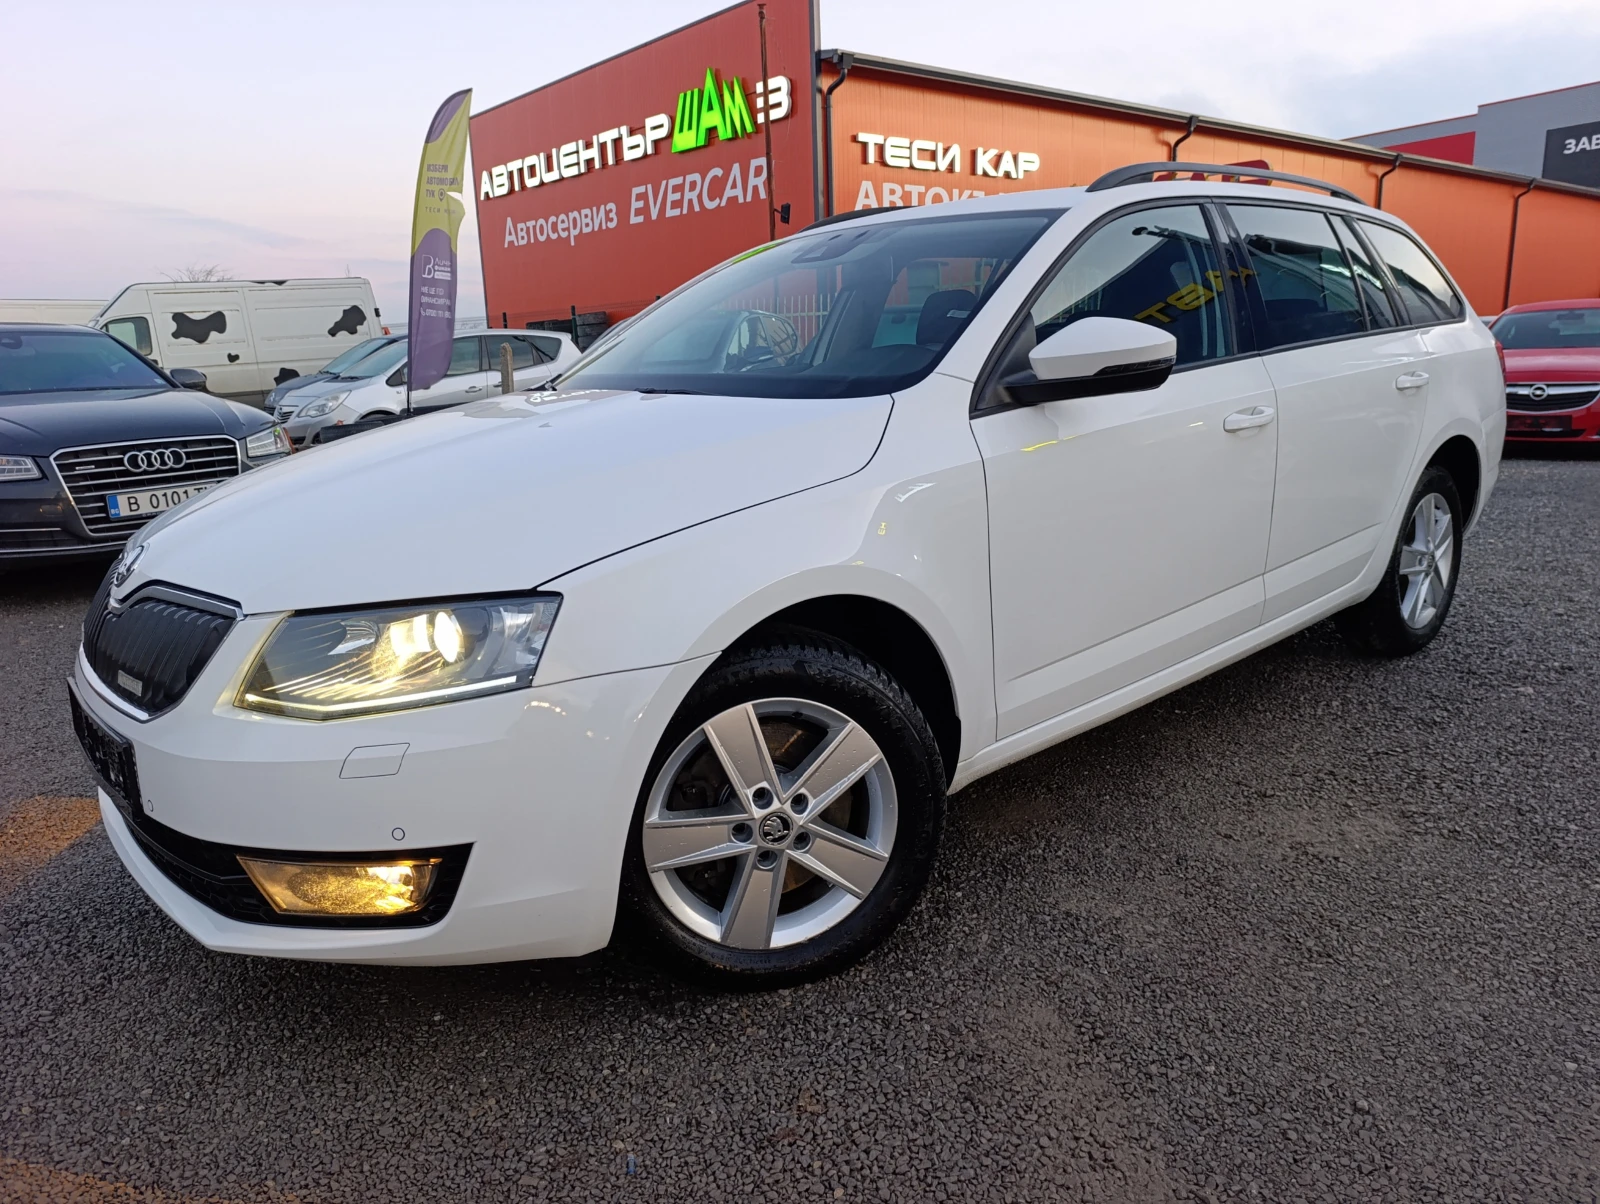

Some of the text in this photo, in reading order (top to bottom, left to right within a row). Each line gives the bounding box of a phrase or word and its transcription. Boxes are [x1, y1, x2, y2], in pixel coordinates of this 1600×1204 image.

[480, 113, 671, 200] АВТОЦЕНТЪР
[671, 67, 755, 153] ШАМ
[855, 132, 1040, 179] ТЕСИ КАР
[629, 156, 770, 225] EVERCAR
[504, 202, 617, 248] Автосервиз
[127, 496, 140, 512] B
[149, 489, 190, 509] 0101
